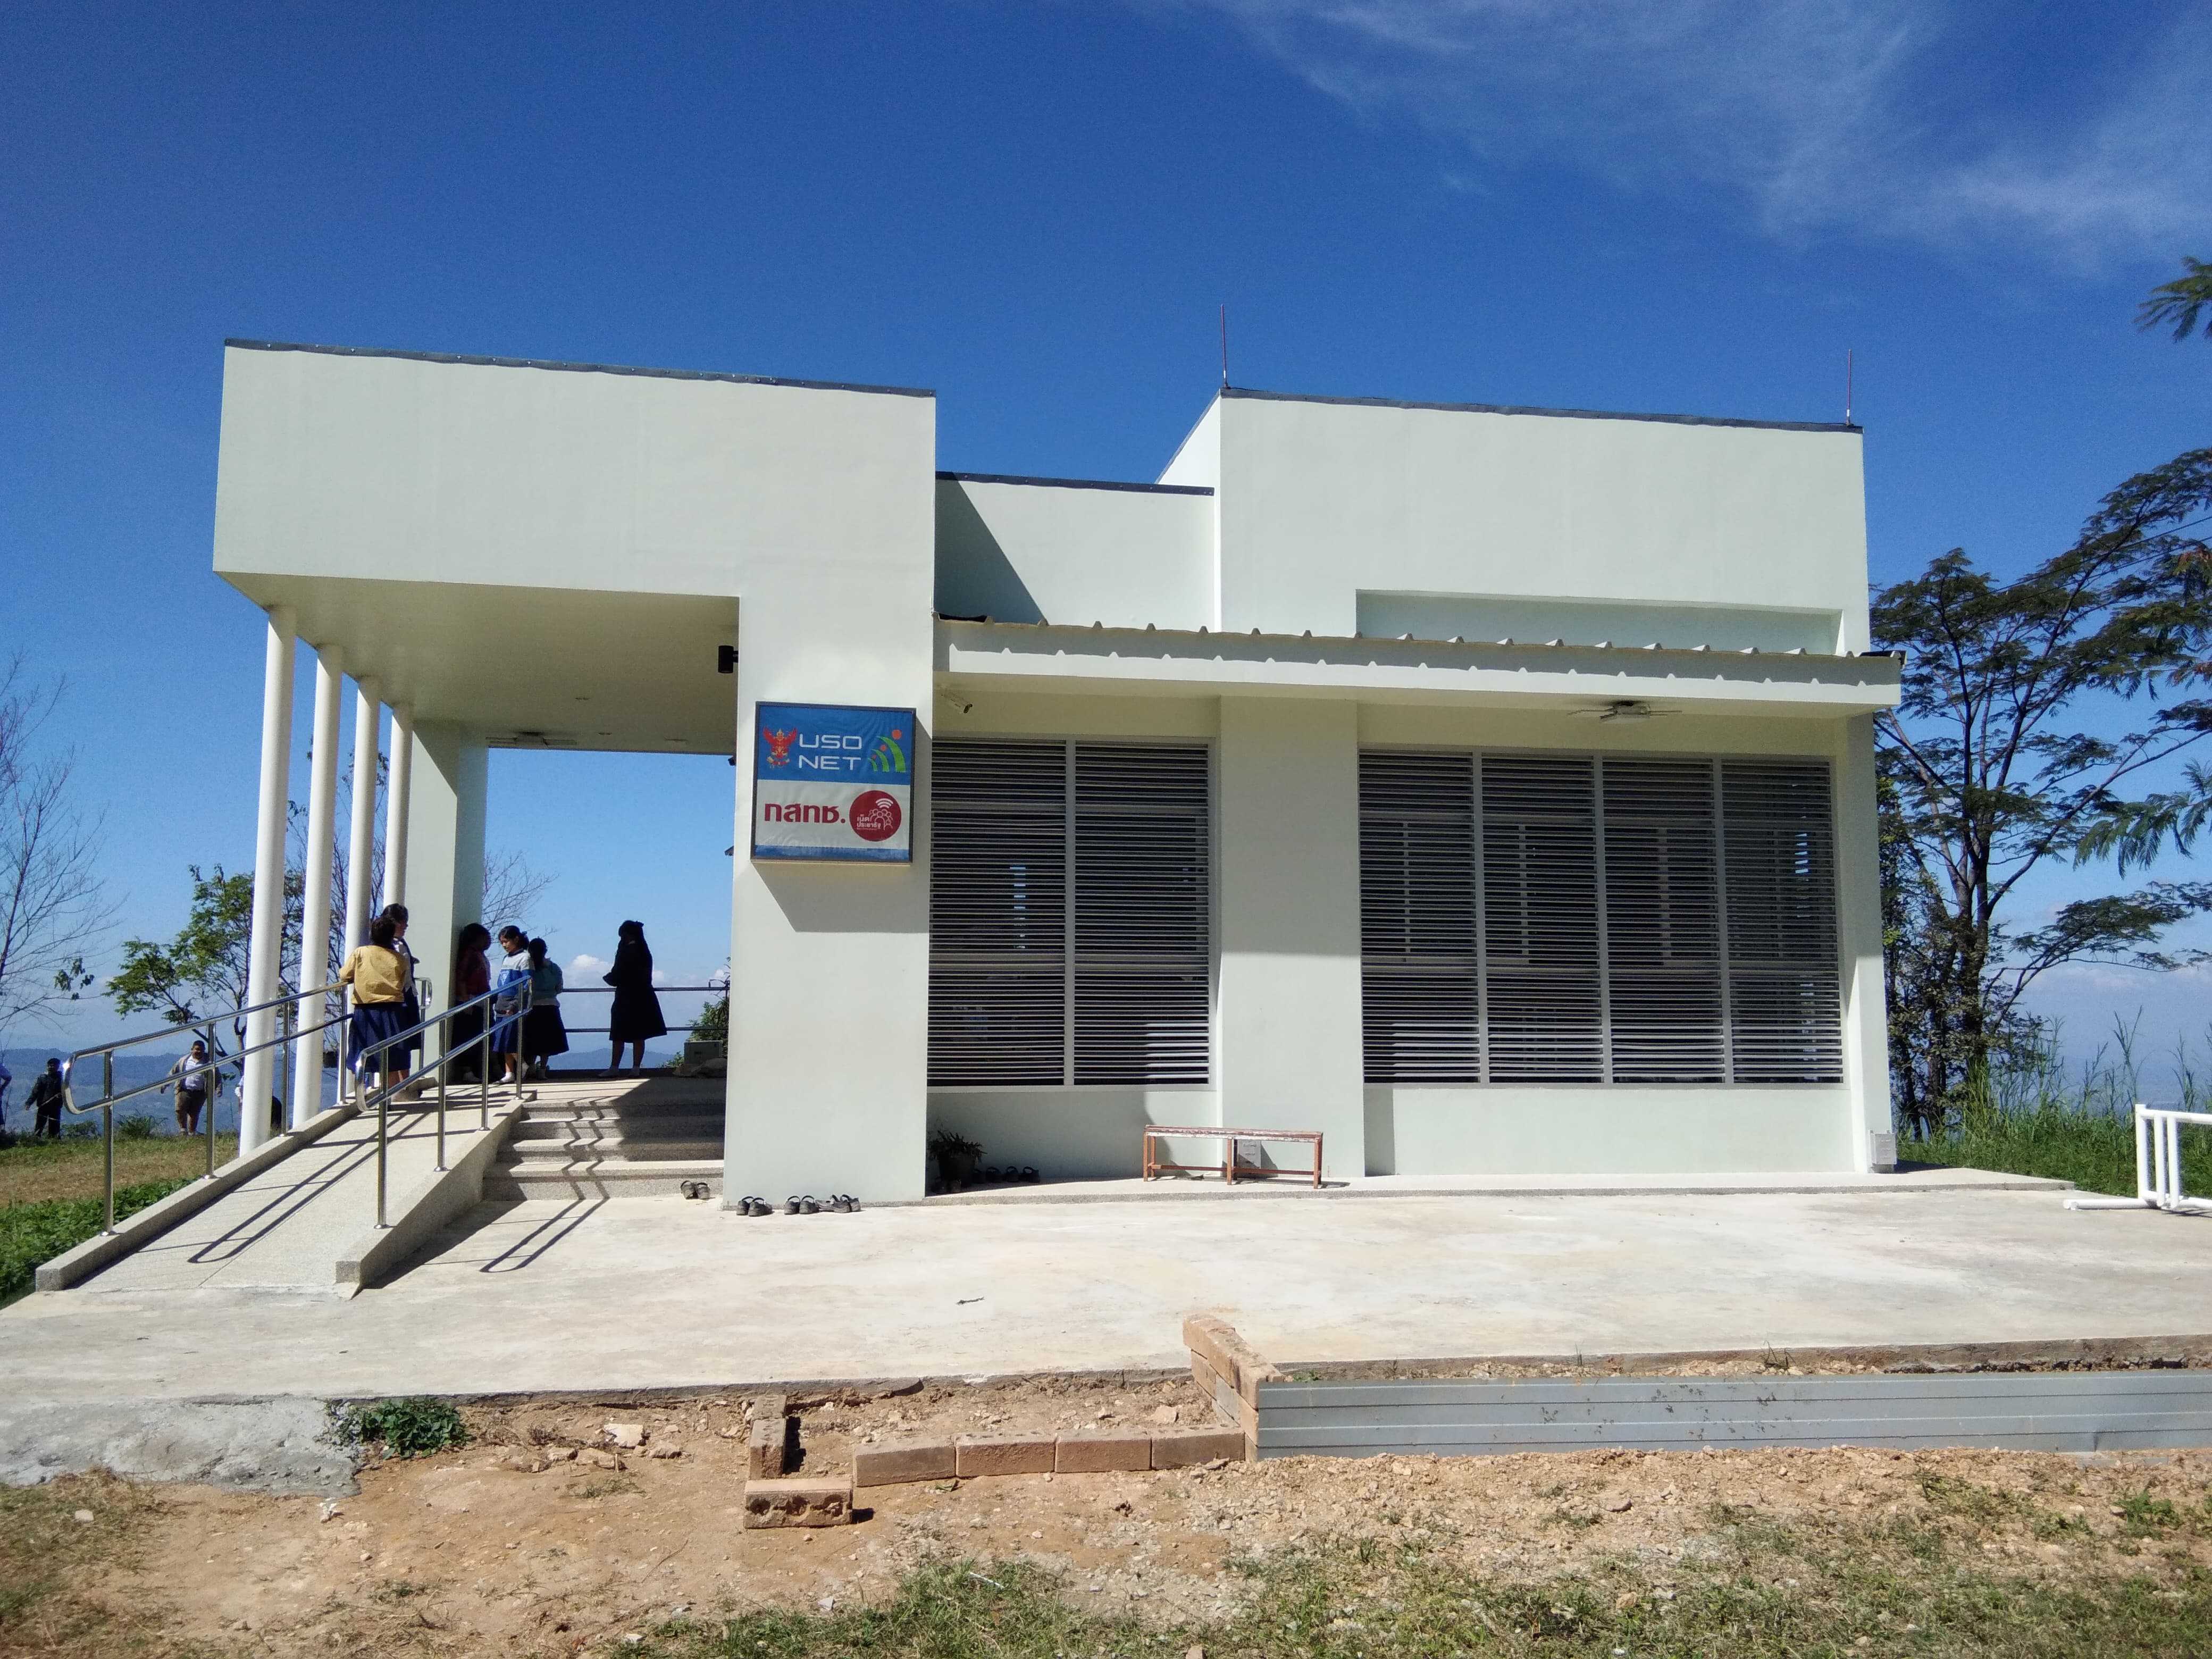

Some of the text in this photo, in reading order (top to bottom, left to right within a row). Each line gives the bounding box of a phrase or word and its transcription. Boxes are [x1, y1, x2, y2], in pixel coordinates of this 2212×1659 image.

[799, 734, 862, 750] USO
[799, 755, 861, 770] NET
[764, 803, 846, 824] กสทช.
